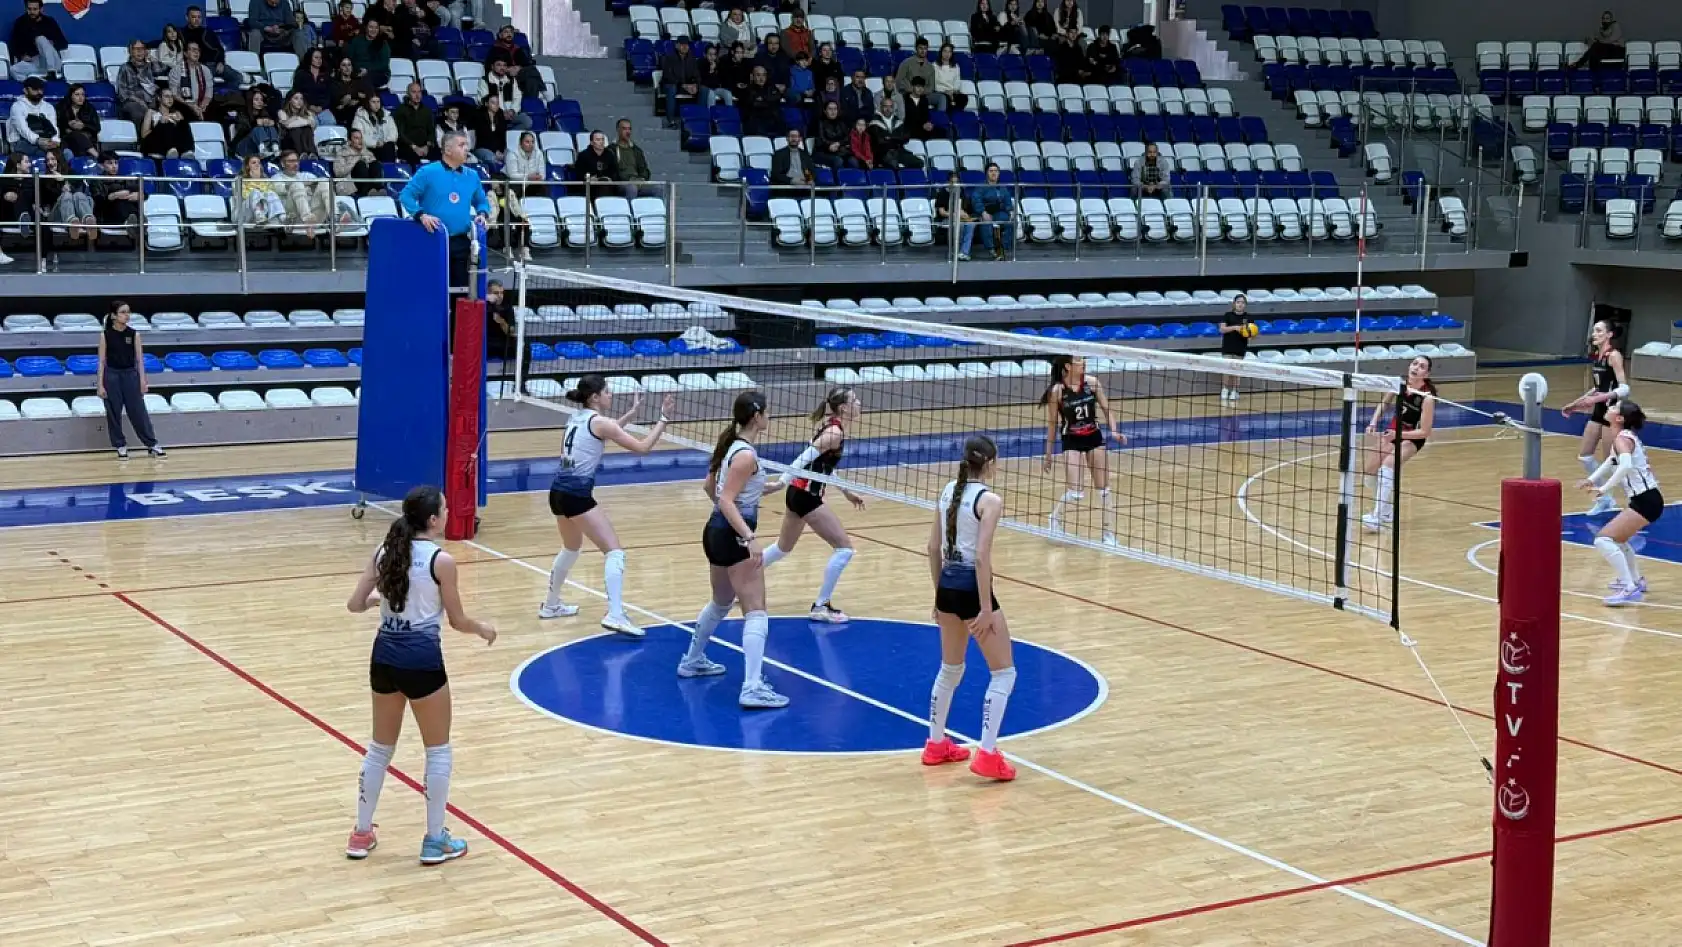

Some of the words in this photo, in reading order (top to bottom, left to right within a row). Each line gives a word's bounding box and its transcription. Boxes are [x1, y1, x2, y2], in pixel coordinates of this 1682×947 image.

[1075, 404, 1089, 419] 21
[564, 426, 578, 455] 4
[126, 481, 355, 506] BESK
